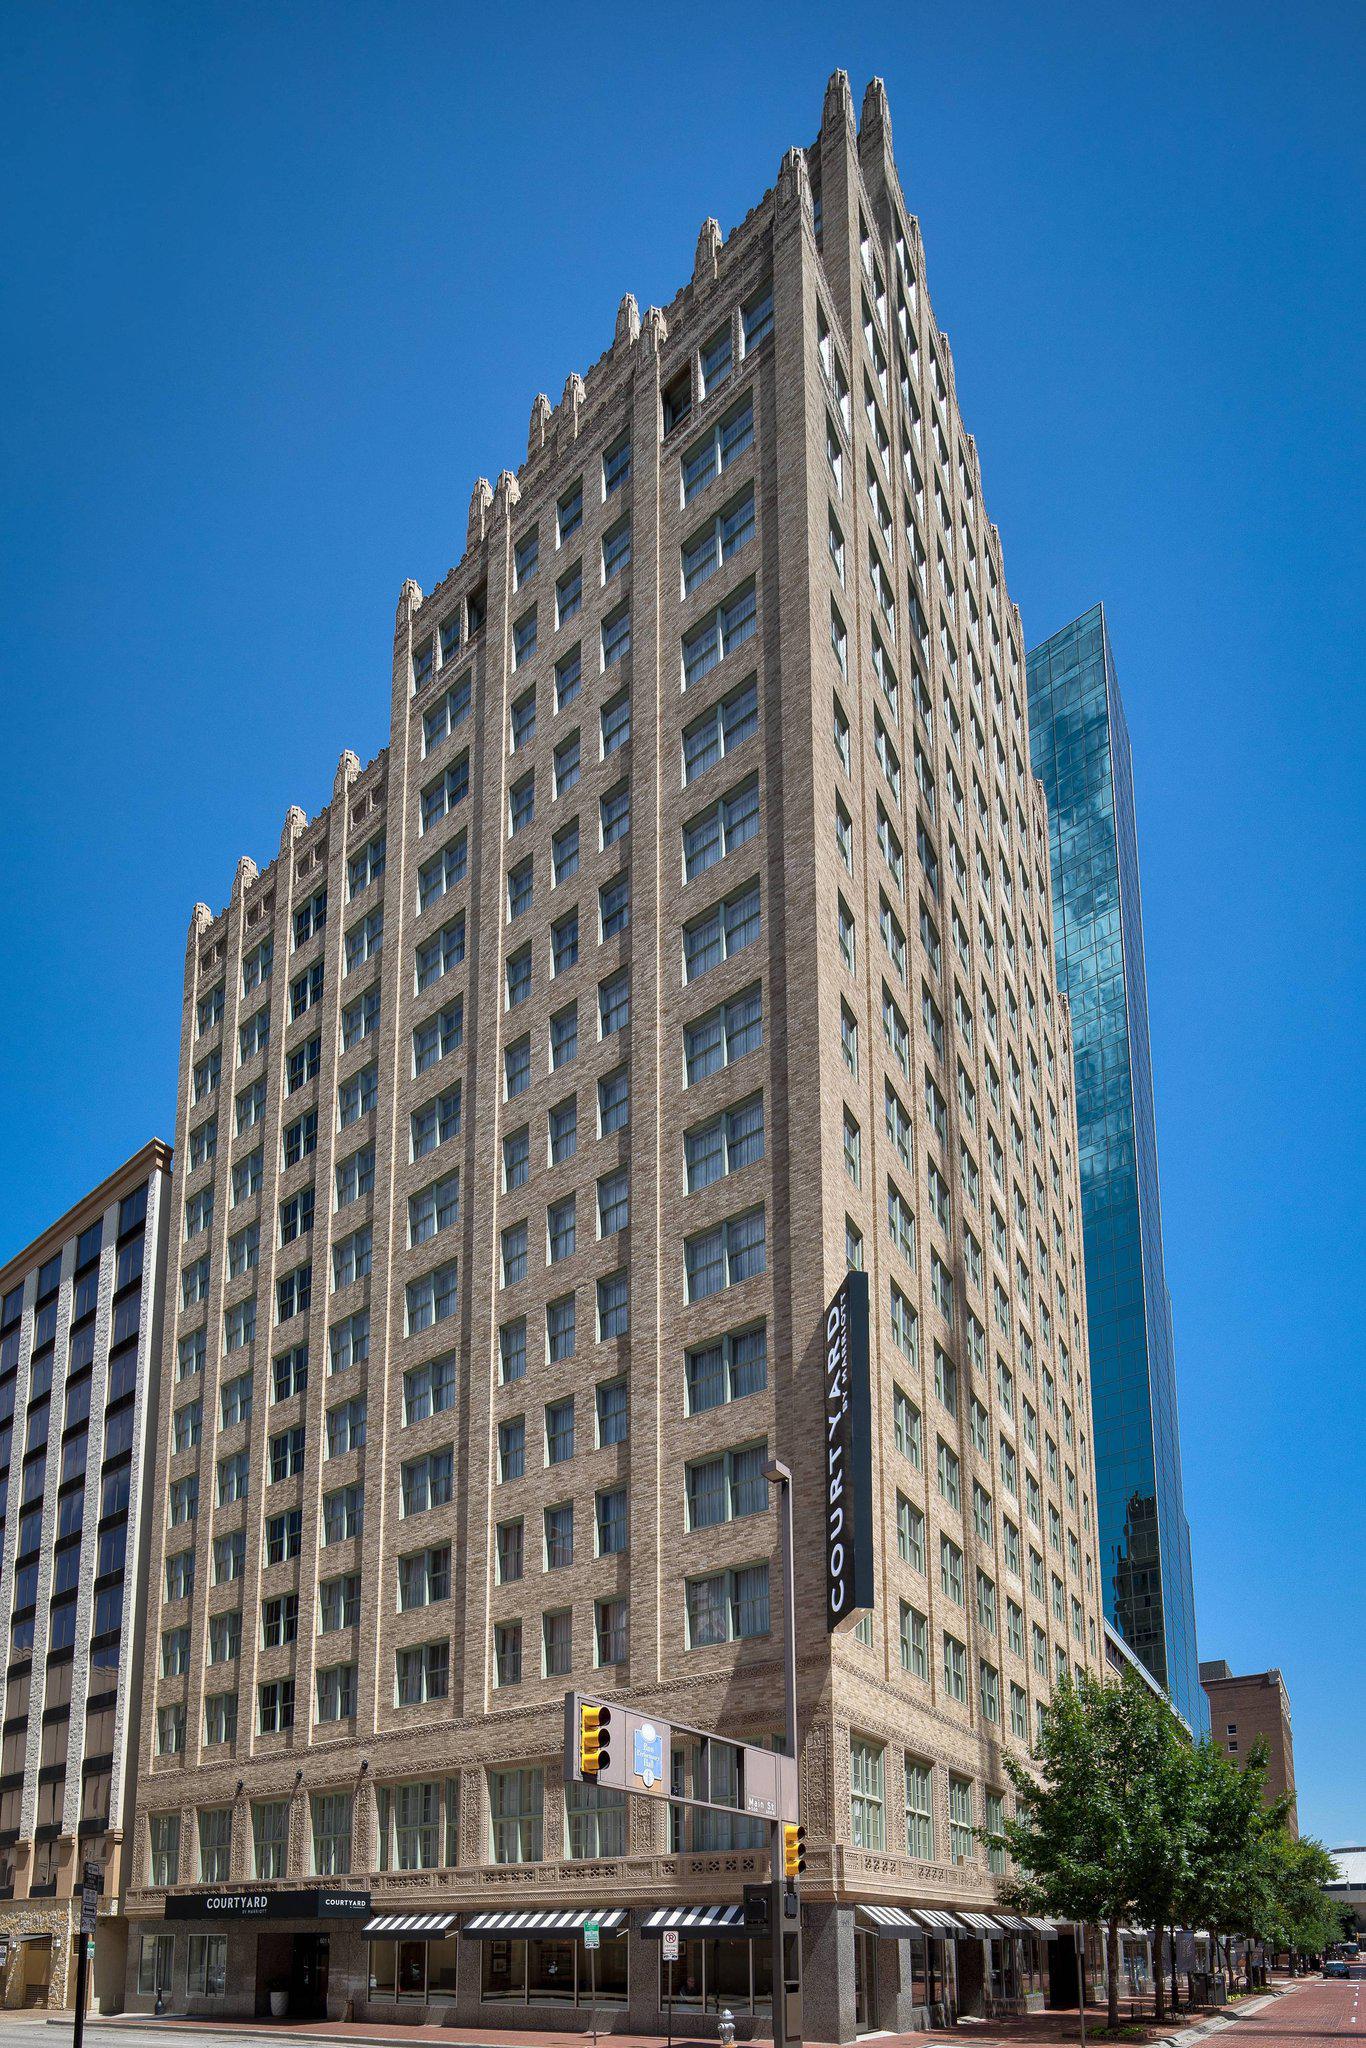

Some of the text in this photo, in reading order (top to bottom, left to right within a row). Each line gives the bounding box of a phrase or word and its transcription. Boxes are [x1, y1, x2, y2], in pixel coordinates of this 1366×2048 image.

[840, 1292, 848, 1385] MARRIOTT
[827, 1306, 845, 1612] COURTYARD
[748, 1797, 765, 1809] Main
[767, 1801, 776, 1812] St
[206, 1896, 268, 1909] COURTYARD
[325, 1898, 366, 1907] COURTYARD
